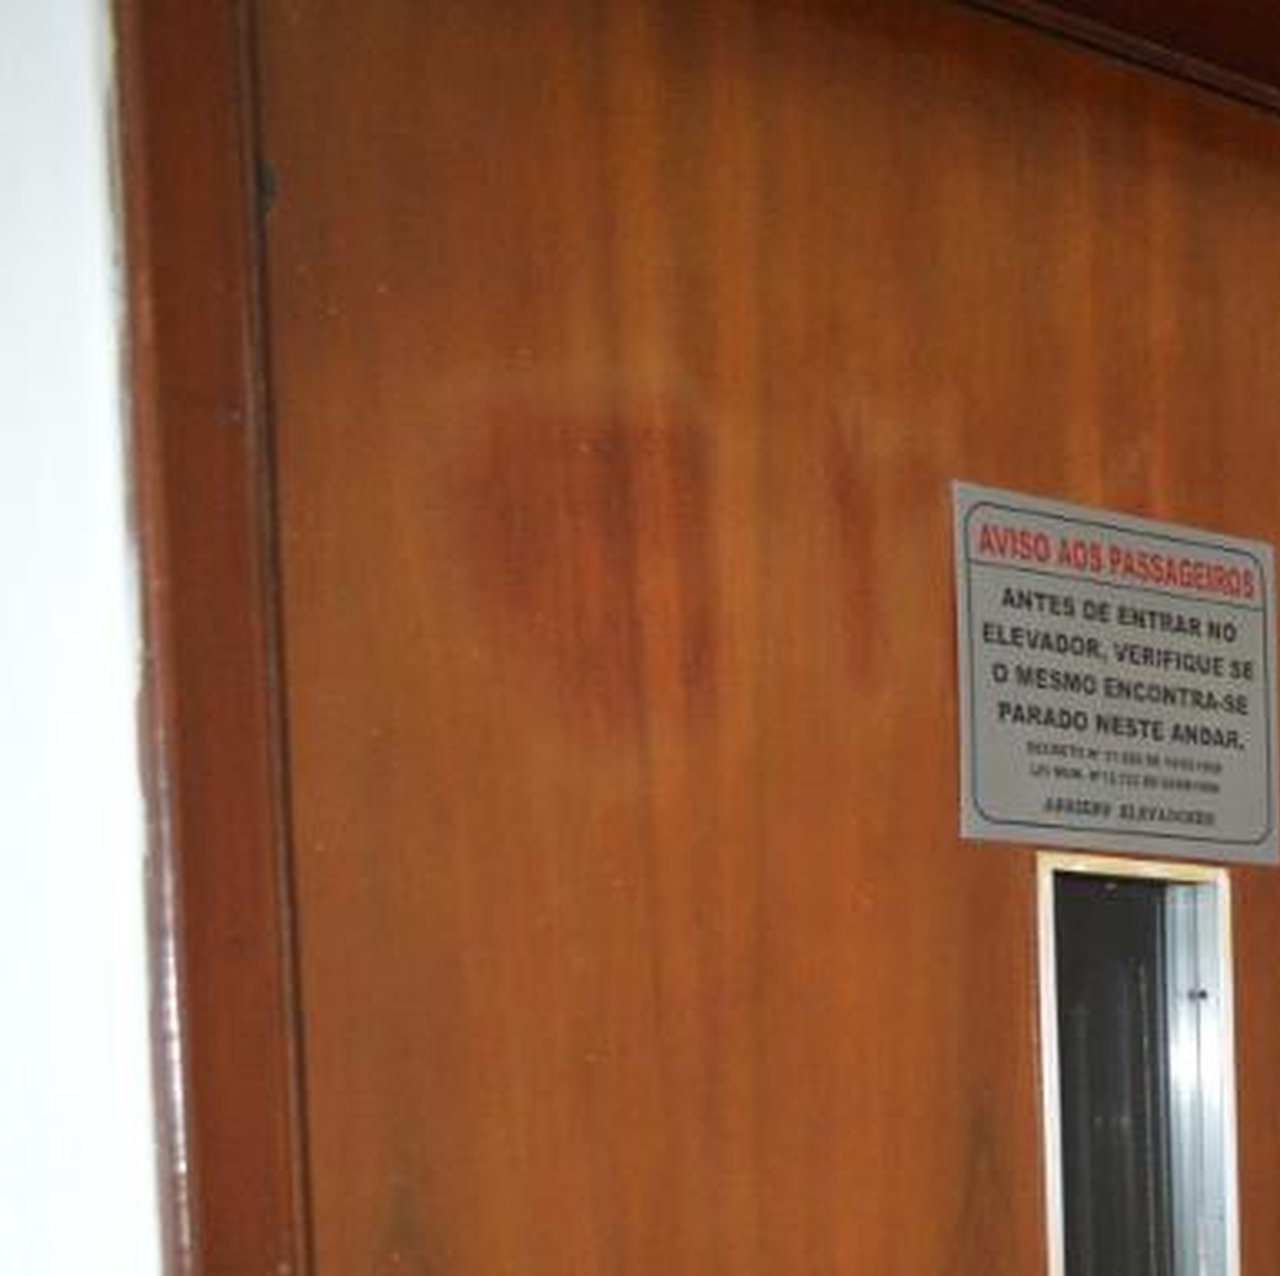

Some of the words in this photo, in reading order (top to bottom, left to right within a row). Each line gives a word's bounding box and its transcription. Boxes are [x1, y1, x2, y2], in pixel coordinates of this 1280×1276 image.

[979, 524, 1049, 562] AVISO
[1058, 538, 1101, 572] AOS
[1109, 546, 1255, 598] PASSAGEIROS
[1002, 588, 1075, 617] ANTES
[1083, 600, 1111, 622] DE
[1117, 605, 1200, 635] ENTRAR
[1207, 619, 1238, 643] NO
[982, 622, 1107, 662] ELEVADOR,
[1113, 642, 1223, 677] VERIFIQUE
[1230, 660, 1254, 681] SE
[992, 663, 1009, 684] O
[1015, 664, 1098, 696] MESMO
[1104, 676, 1249, 716] ENCONTRA-SE
[998, 700, 1089, 731] PARADO
[1095, 714, 1164, 742] NESTE
[1171, 722, 1246, 750] ANDAR.
